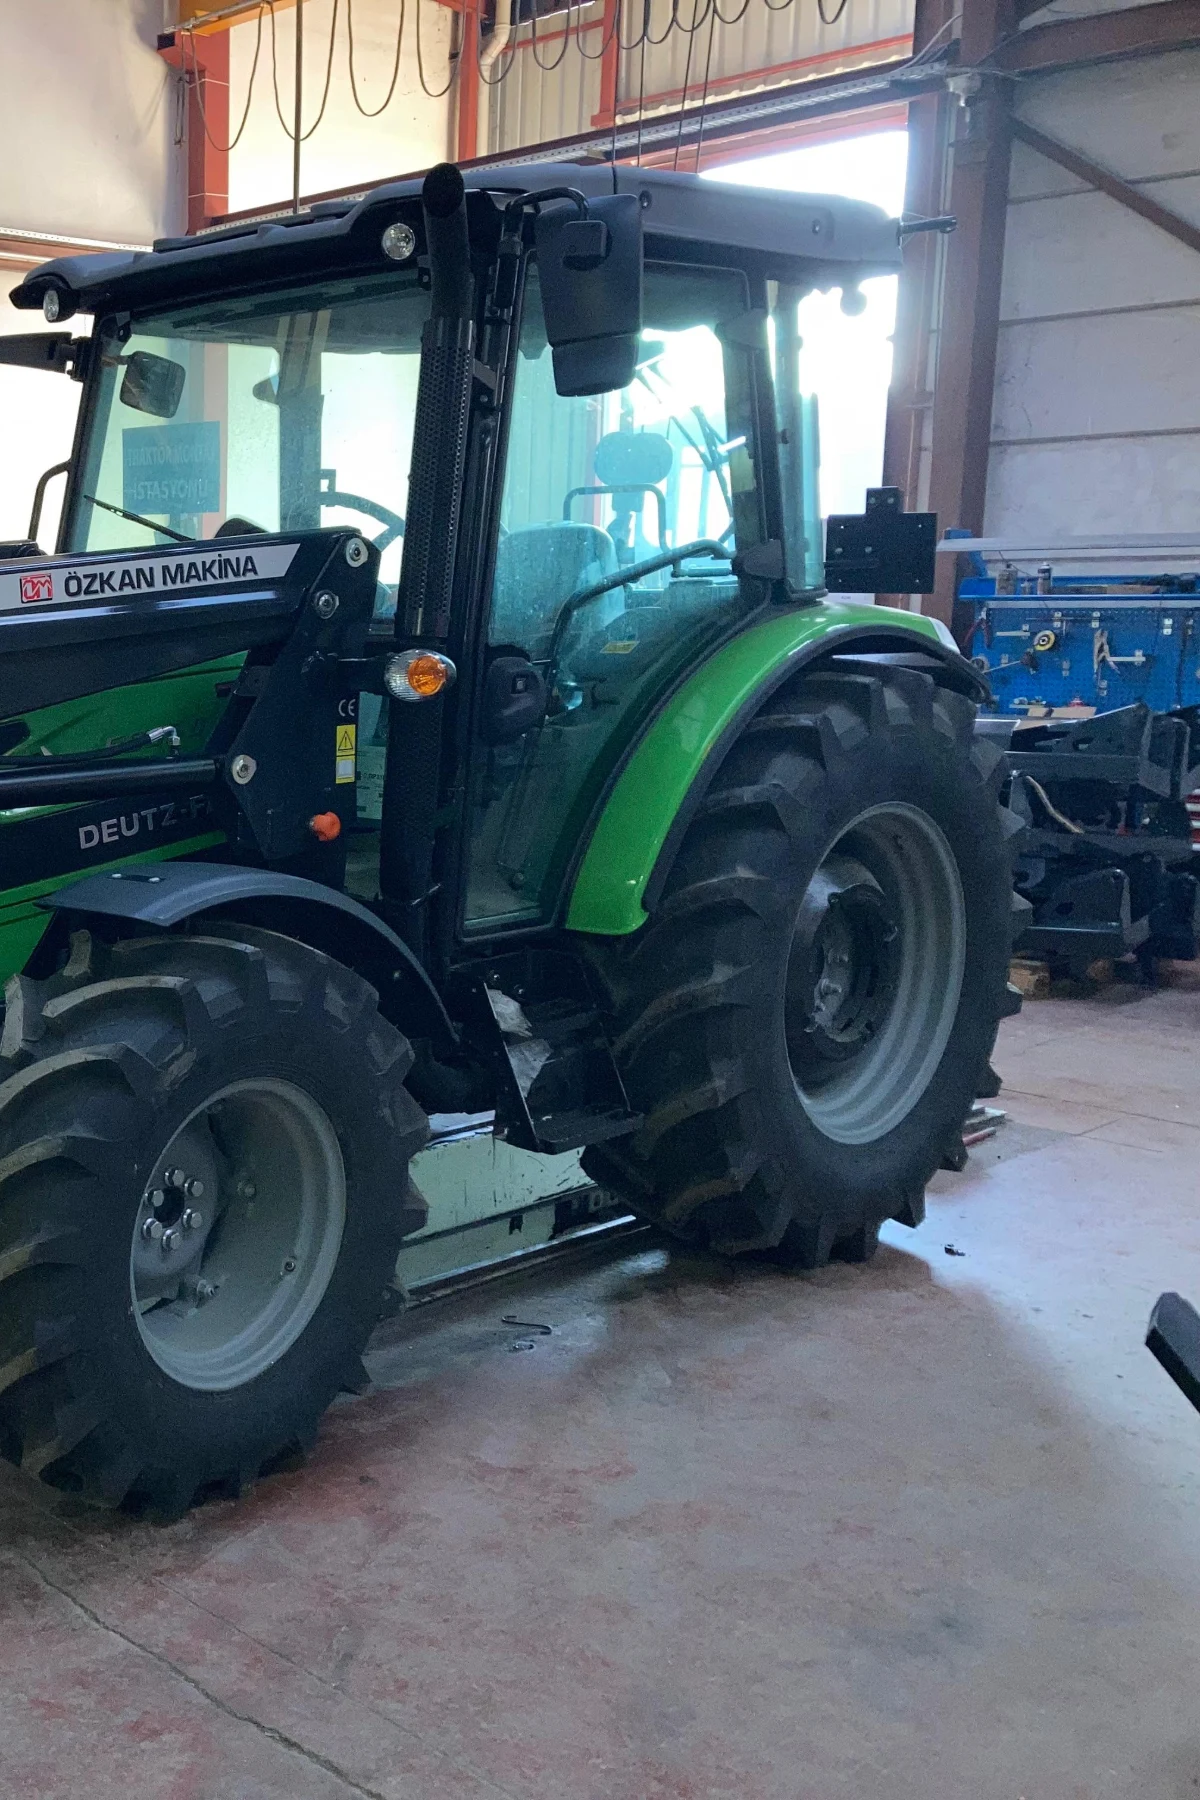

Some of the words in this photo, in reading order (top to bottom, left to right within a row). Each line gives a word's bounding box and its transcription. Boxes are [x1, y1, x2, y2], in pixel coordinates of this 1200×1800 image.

[64, 566, 155, 597] ÖZKAN
[162, 554, 259, 586] MAKİNA
[78, 794, 212, 850] DEUTZ-F
